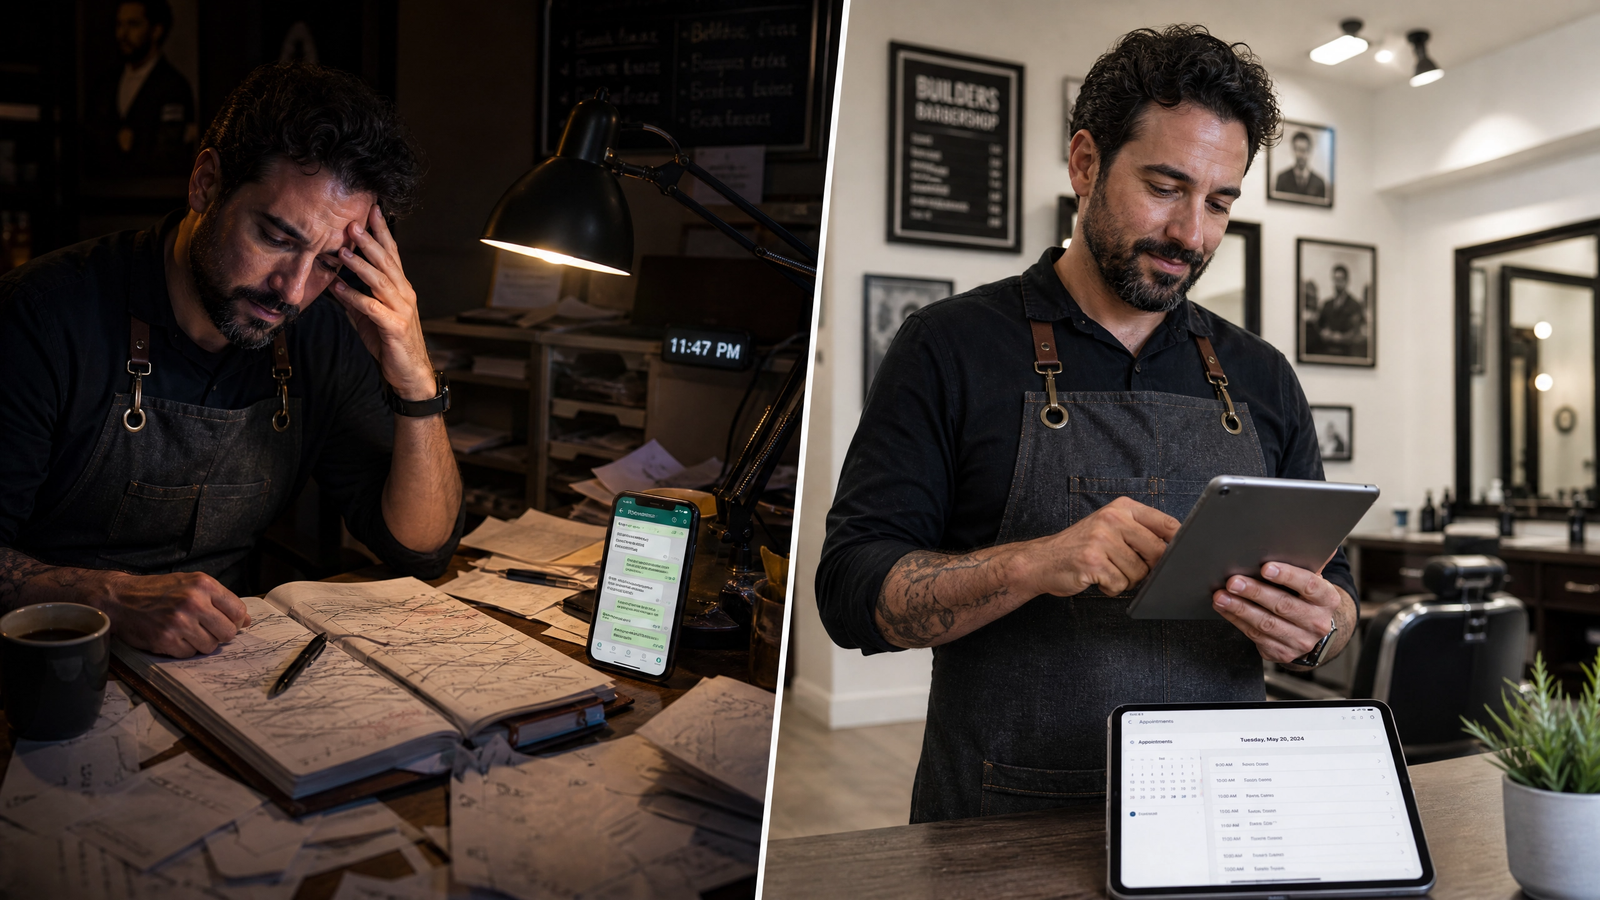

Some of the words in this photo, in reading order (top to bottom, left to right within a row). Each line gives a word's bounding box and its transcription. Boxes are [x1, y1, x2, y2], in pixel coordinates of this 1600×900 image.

[915, 74, 999, 112] BUILDERS
[915, 101, 999, 132] BARBERSHOP
[670, 337, 712, 356] 11:47
[716, 342, 741, 360] PM
